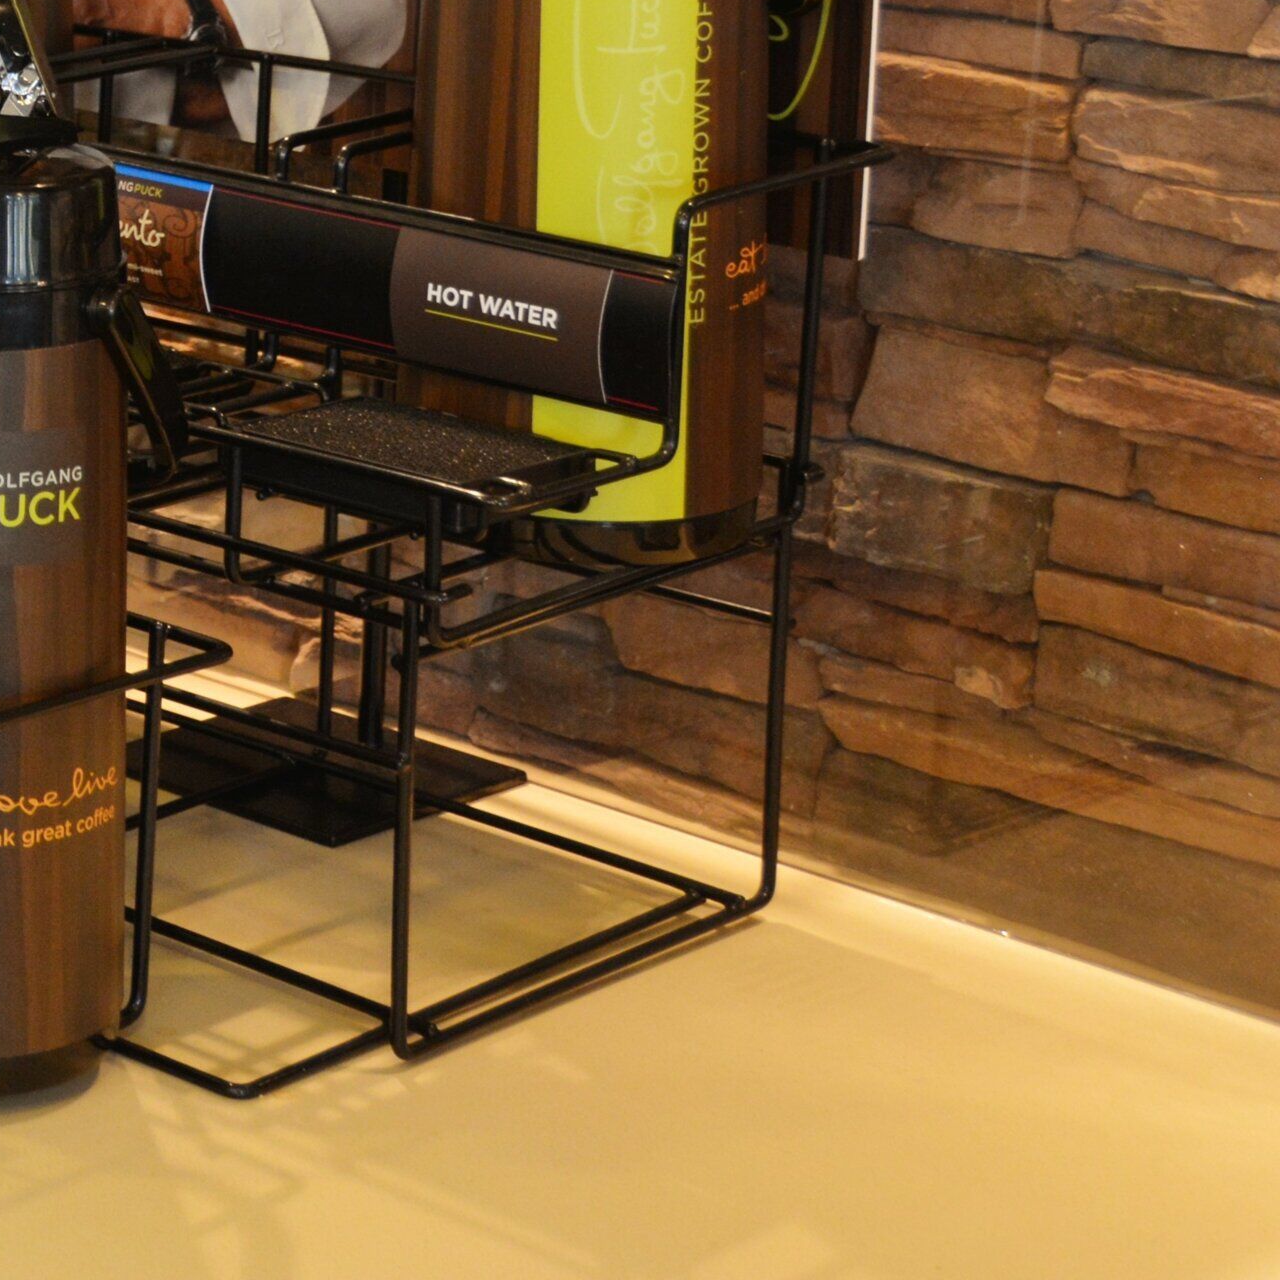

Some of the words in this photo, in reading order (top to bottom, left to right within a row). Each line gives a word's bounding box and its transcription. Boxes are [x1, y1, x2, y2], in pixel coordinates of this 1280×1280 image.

[692, 80, 710, 196] GROWN
[688, 210, 708, 324] ESTATE
[427, 282, 474, 310] HOT
[479, 292, 558, 330] WATER
[62, 766, 119, 807] live
[22, 819, 73, 849] great
[76, 804, 116, 834] coffee
